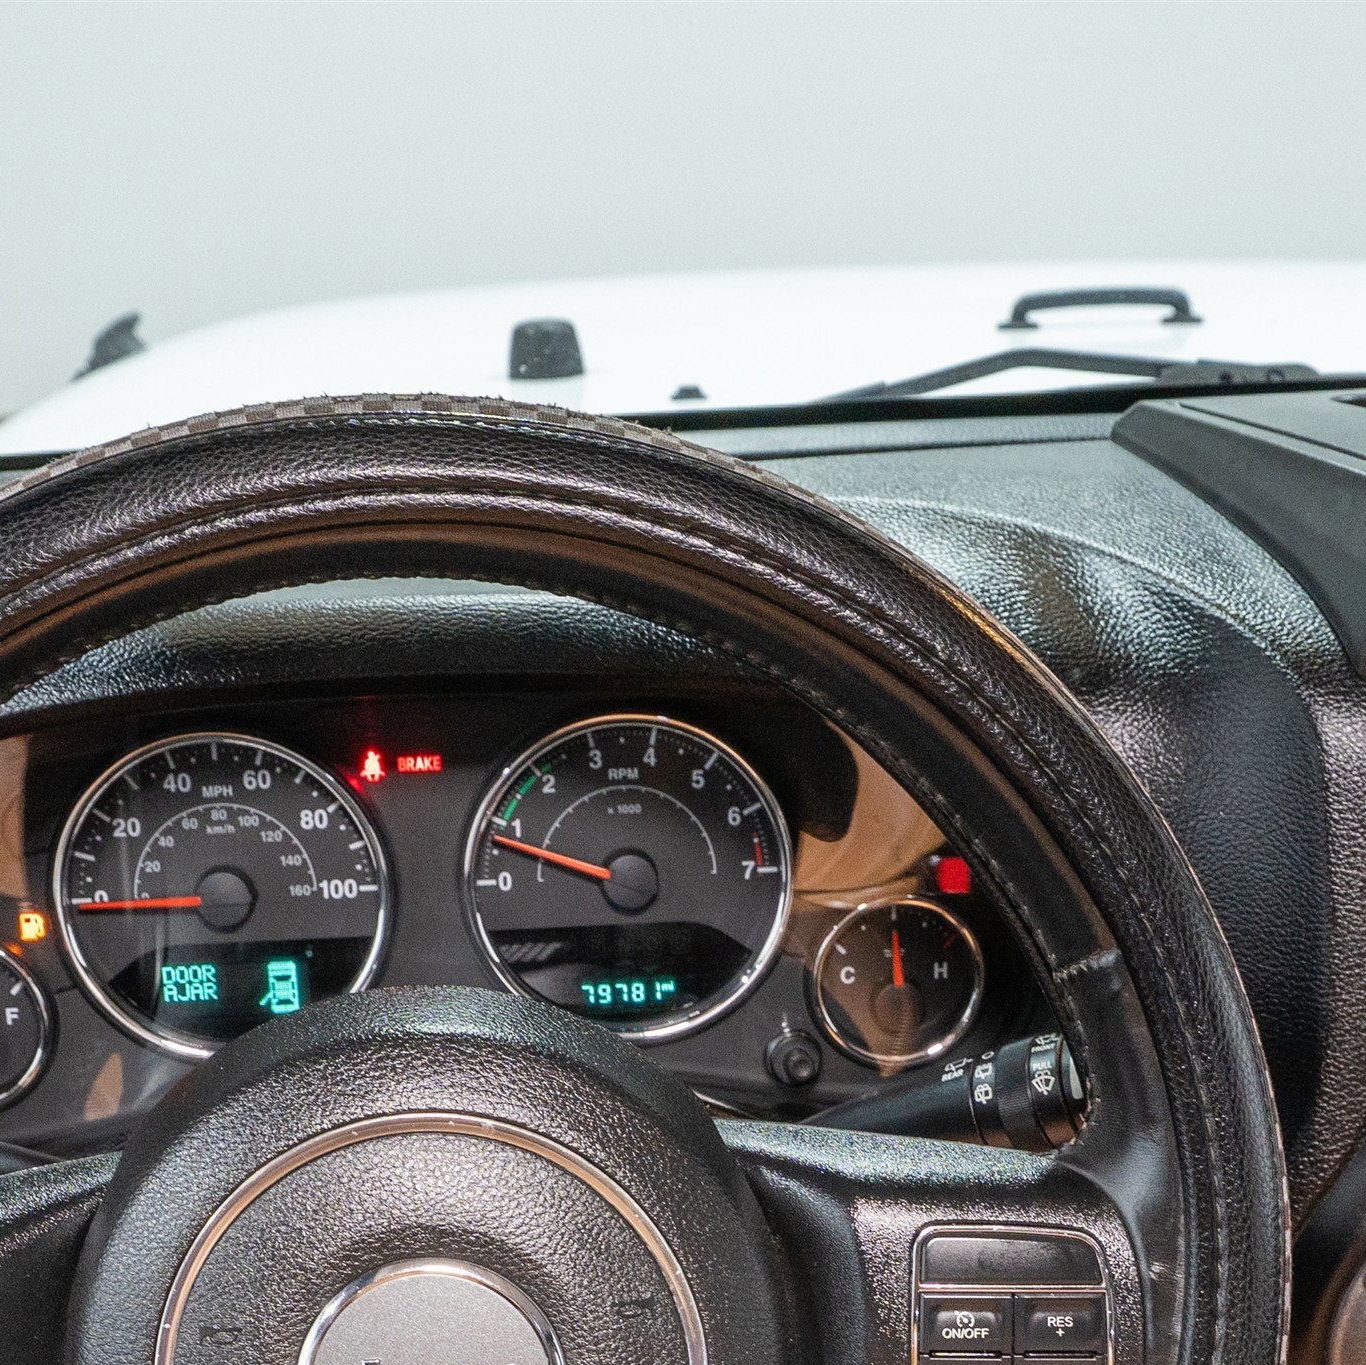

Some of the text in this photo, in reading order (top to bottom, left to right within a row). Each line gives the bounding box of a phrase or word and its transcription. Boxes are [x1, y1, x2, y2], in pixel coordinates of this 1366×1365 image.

[397, 755, 442, 773] BRAKE
[588, 749, 603, 770] 3
[642, 747, 657, 768] 4
[243, 770, 271, 791] 60
[608, 766, 639, 781] RPM
[691, 768, 707, 789] 5
[163, 773, 191, 793] 40
[201, 785, 234, 798] MPH
[540, 773, 556, 794] 2
[210, 808, 227, 821] 80
[617, 803, 642, 814] 1000
[727, 805, 743, 826] 6
[112, 818, 141, 838] 20
[182, 817, 199, 830] 60
[206, 822, 235, 835] km/h
[237, 815, 260, 828] 100
[300, 809, 329, 830] 80
[512, 819, 522, 838] 1
[158, 835, 174, 848] 40
[260, 829, 282, 843] 120
[144, 860, 161, 873] 20
[280, 854, 302, 867] 140
[742, 860, 756, 880] 7
[319, 879, 357, 899] 100
[497, 871, 513, 891] 0
[289, 884, 312, 897] 160
[162, 965, 216, 984] DOOR
[840, 966, 856, 984] C
[934, 962, 948, 980] H
[163, 983, 218, 1002] AJAR
[581, 981, 661, 1004] 79781
[5, 1007, 20, 1026] F
[941, 1069, 964, 1083] REAR
[1047, 1316, 1074, 1328] RES
[942, 1328, 990, 1340] ON/OFF
